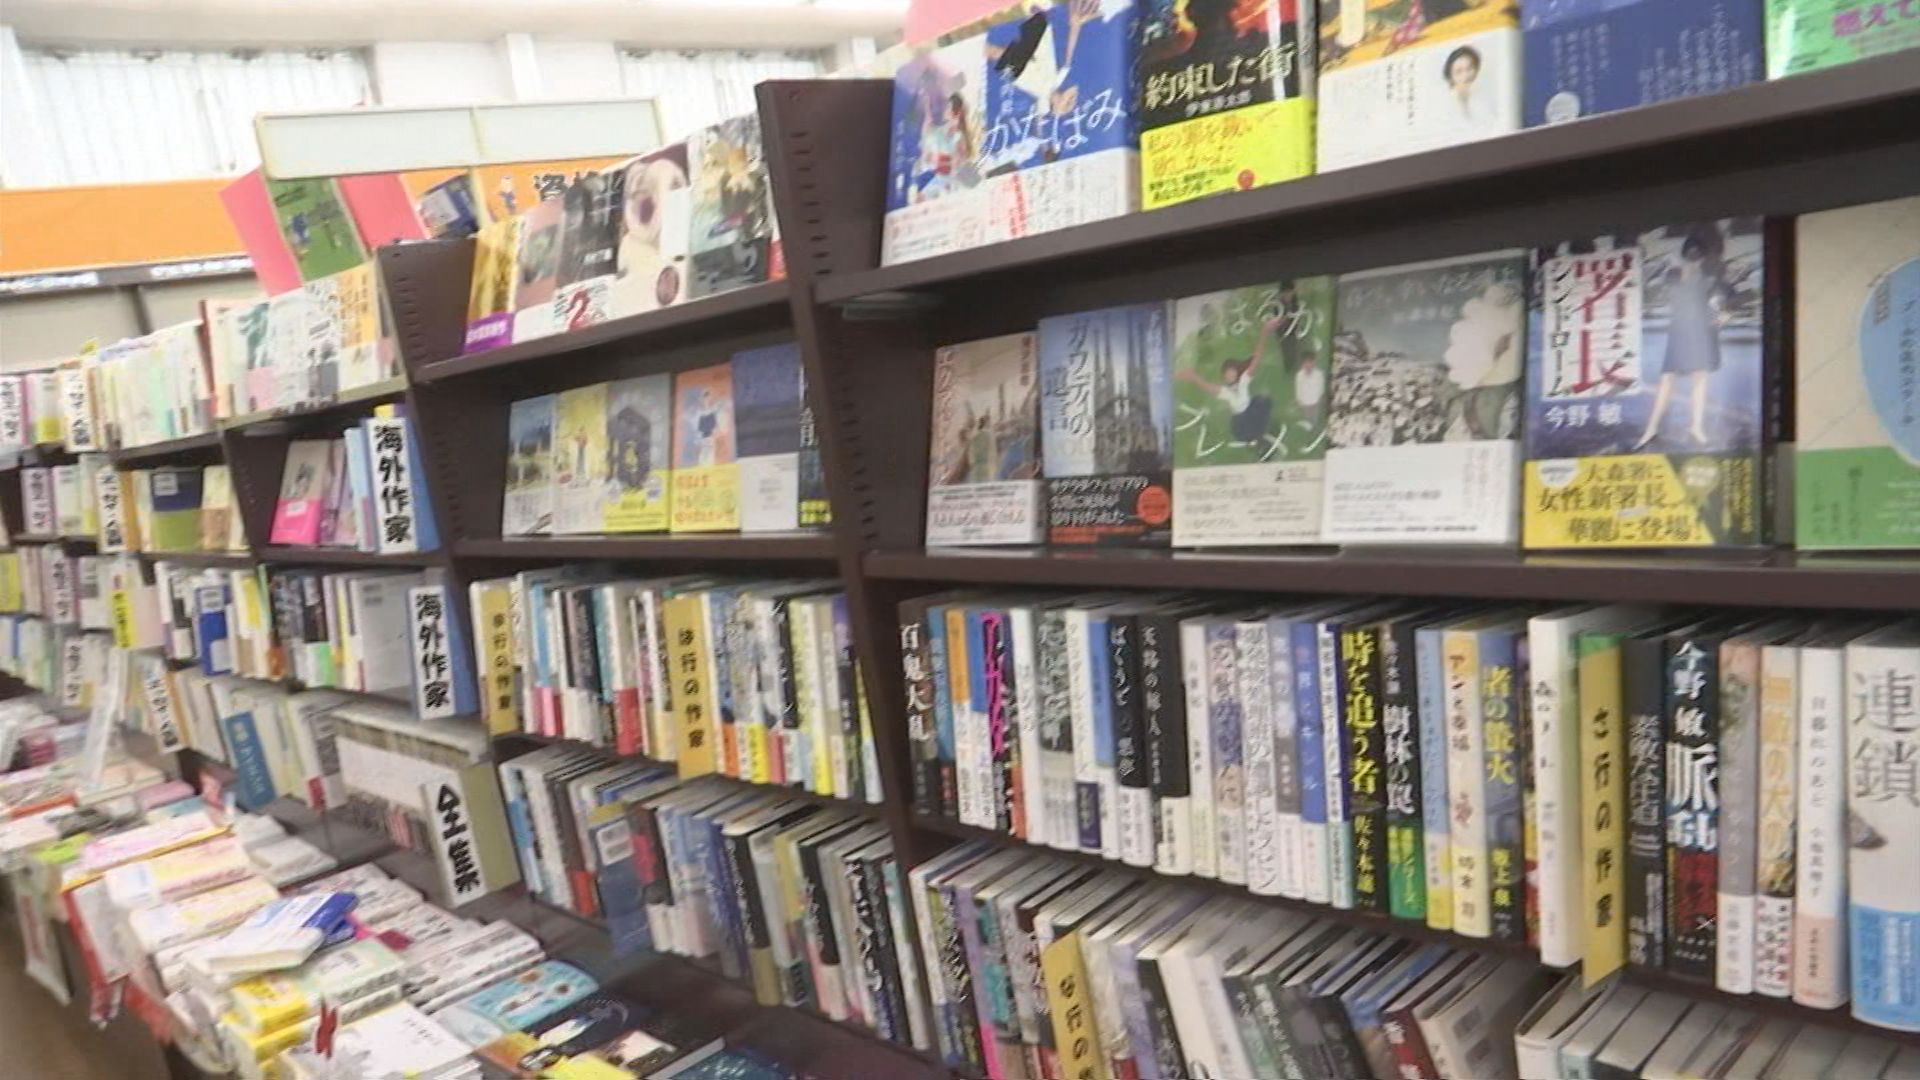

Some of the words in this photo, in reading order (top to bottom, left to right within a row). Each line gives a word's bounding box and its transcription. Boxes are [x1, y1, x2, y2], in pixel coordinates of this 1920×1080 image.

[976, 88, 1127, 169] かたばみ
[1145, 42, 1299, 112] 約束した街
[1548, 260, 1574, 397] シンドローム
[373, 424, 412, 544] 海外作家
[416, 592, 450, 710] 海外作家
[1341, 630, 1379, 794] 時を追う者
[1852, 668, 1920, 810] 連鎖
[1592, 705, 1616, 930] さ行の作家
